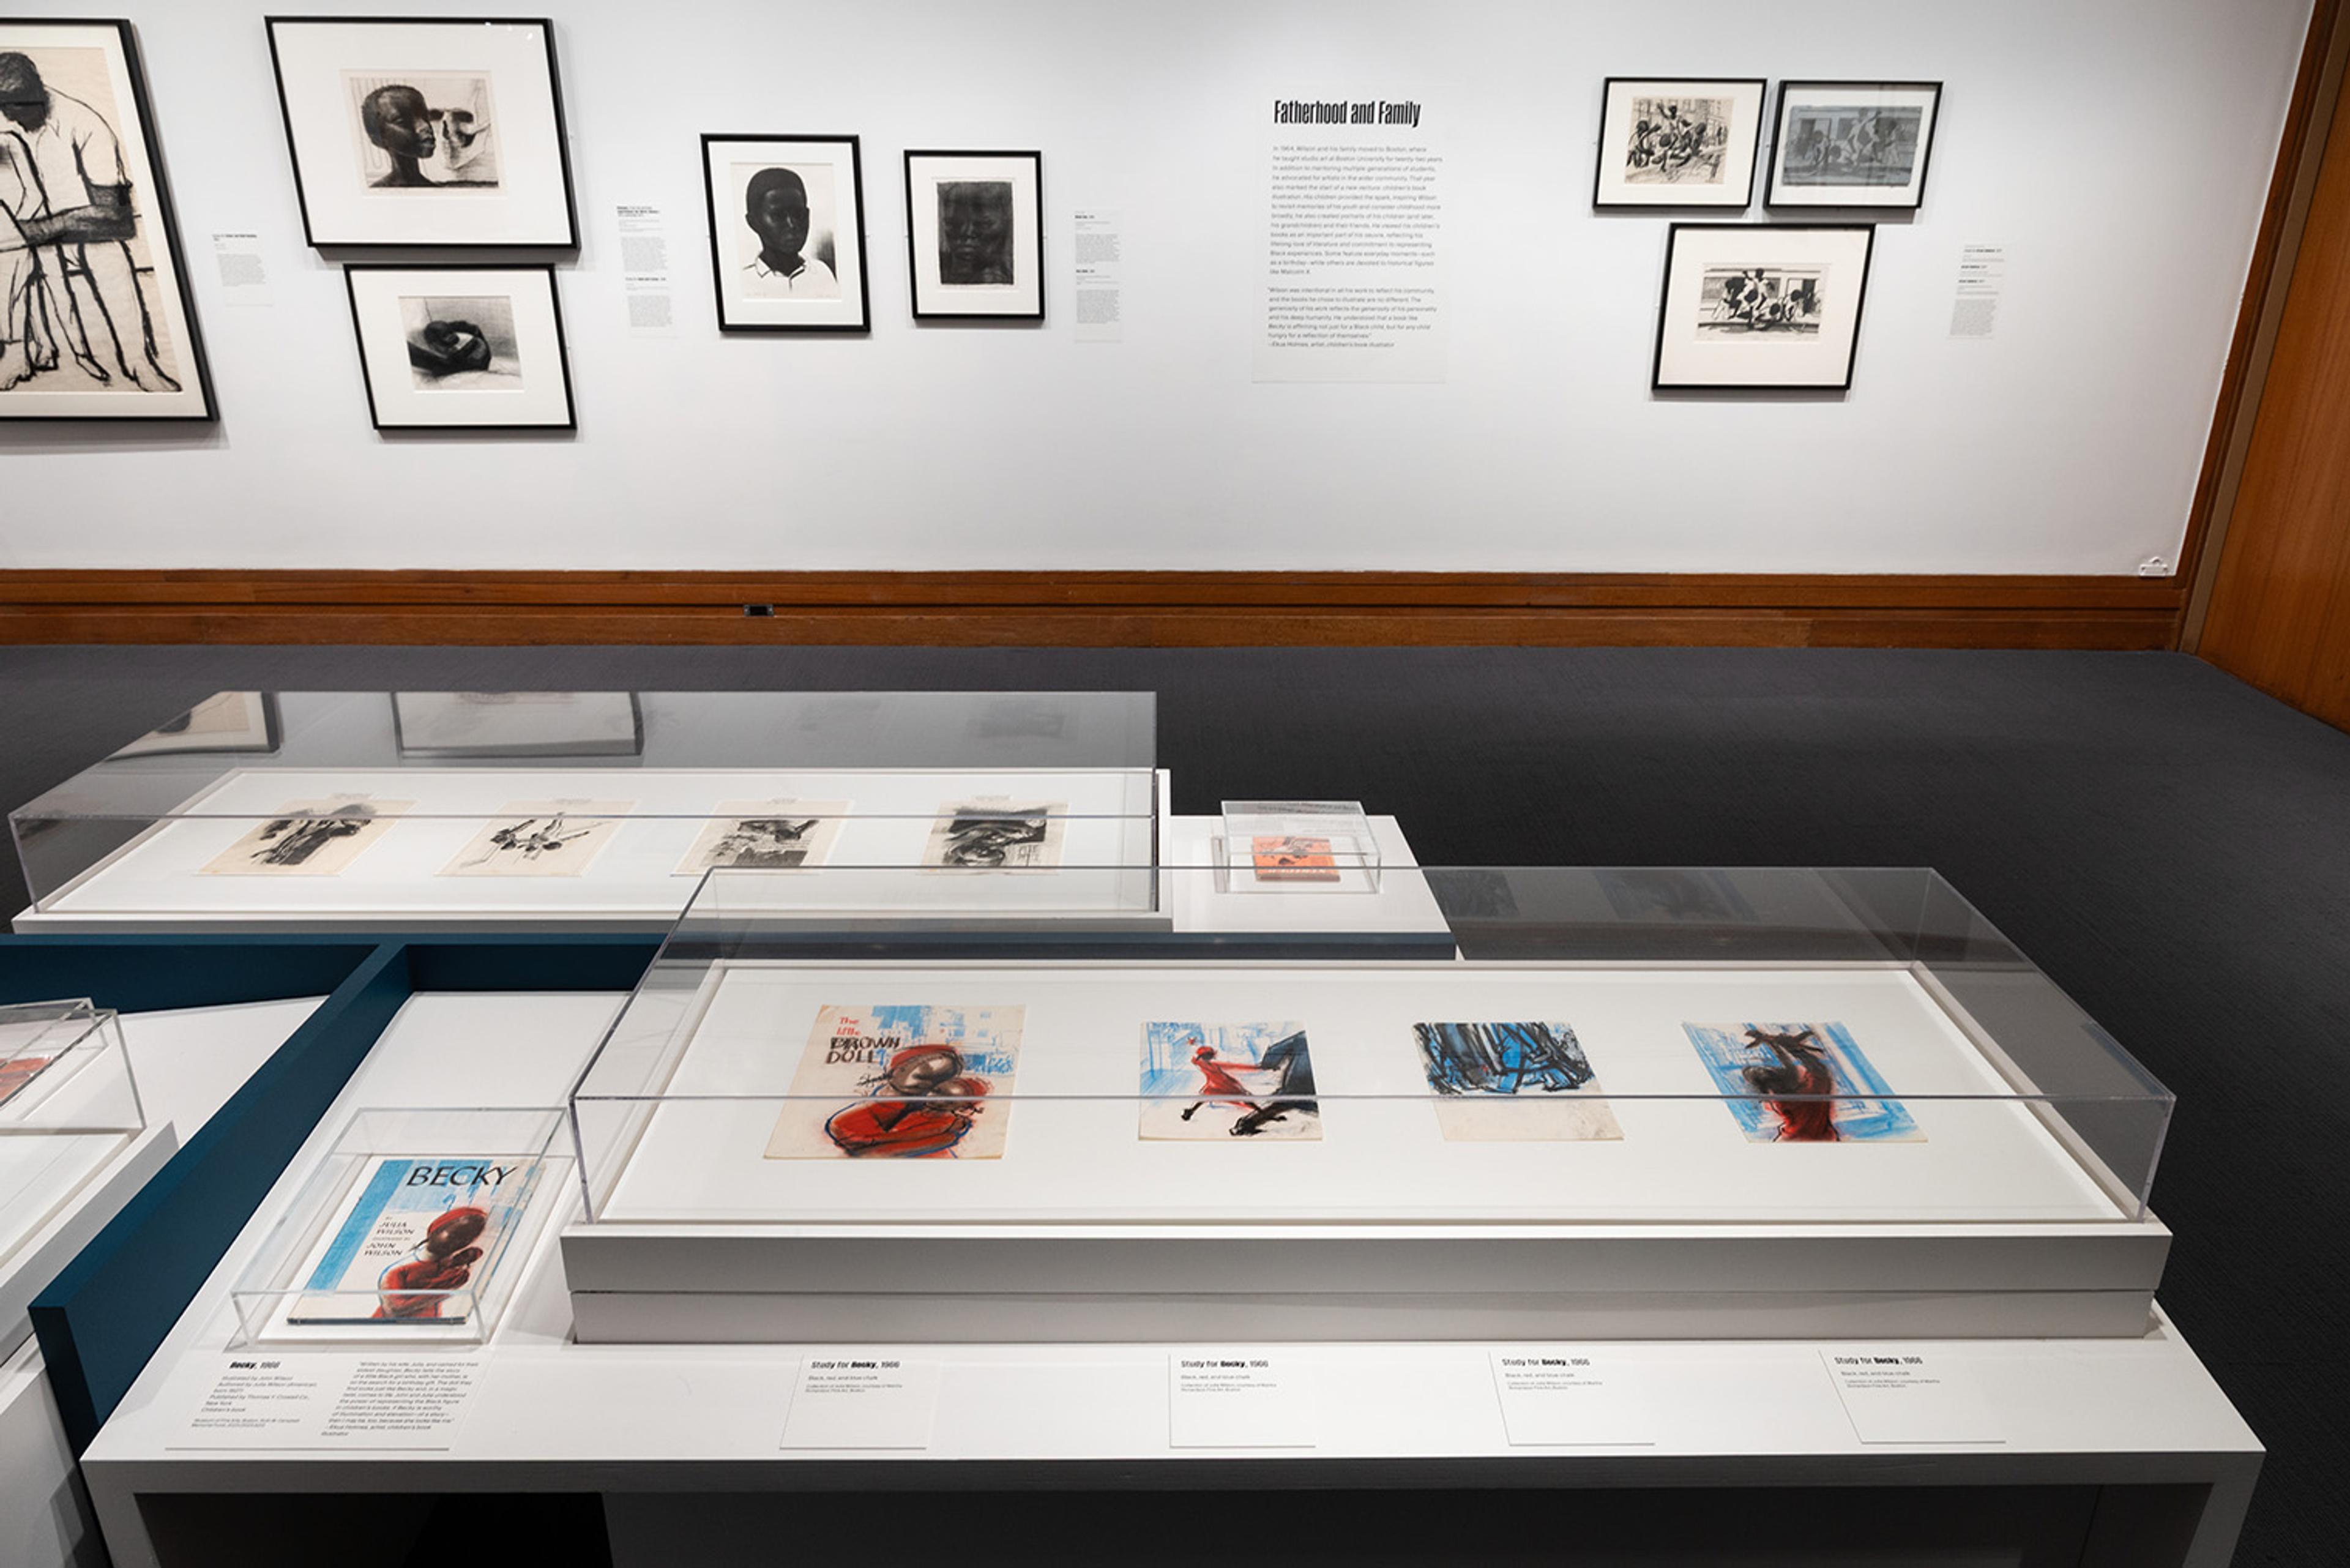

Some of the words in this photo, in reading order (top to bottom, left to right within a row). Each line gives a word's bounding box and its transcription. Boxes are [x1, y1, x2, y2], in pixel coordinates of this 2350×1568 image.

[1274, 100, 1348, 124] Fatherhood
[1351, 100, 1375, 125] and
[1378, 100, 1421, 128] Family
[830, 1036, 901, 1050] BROWN
[826, 1049, 874, 1064] DOLL
[406, 1165, 518, 1187] BECKY
